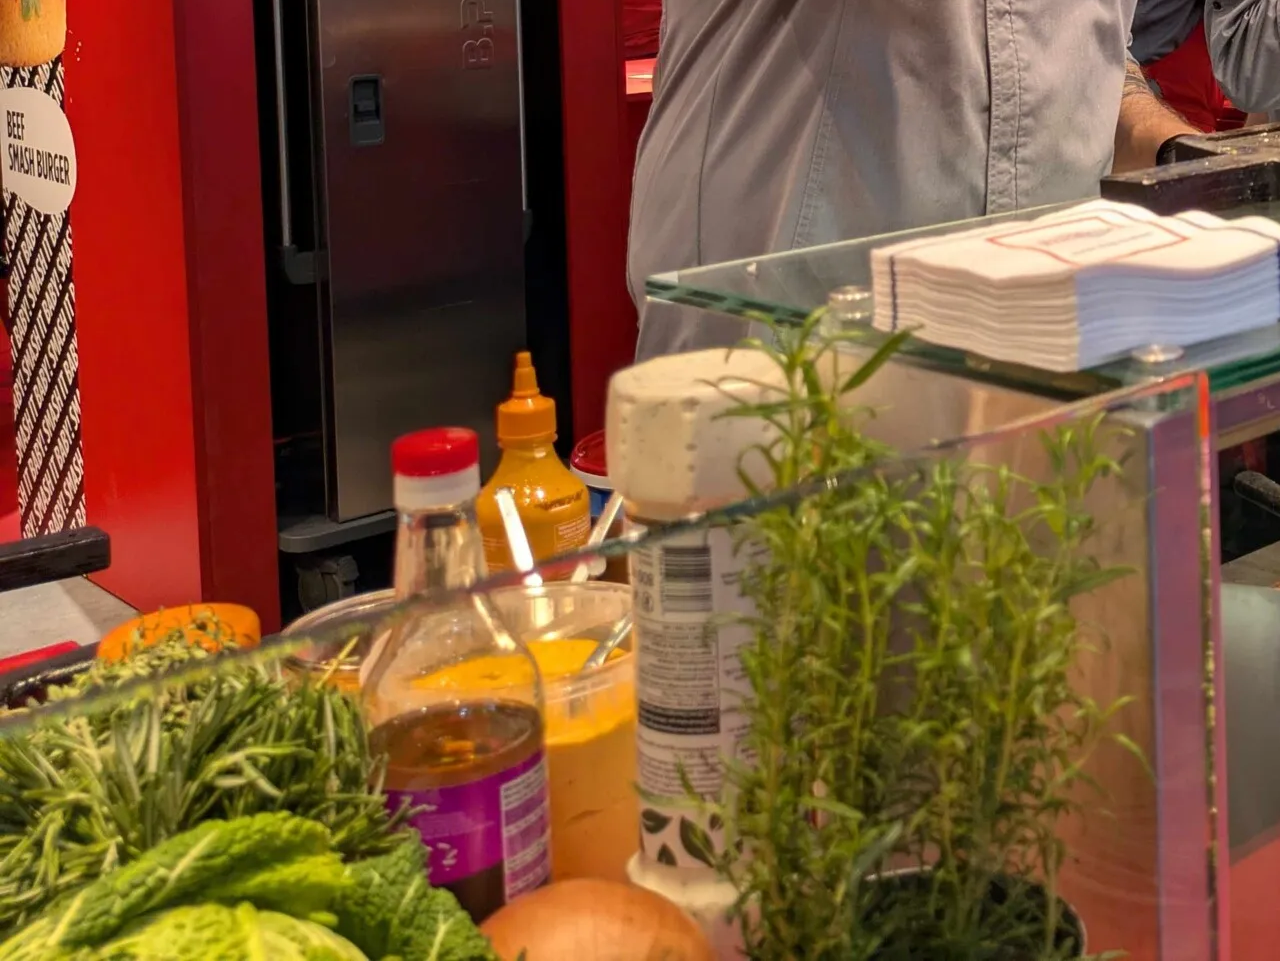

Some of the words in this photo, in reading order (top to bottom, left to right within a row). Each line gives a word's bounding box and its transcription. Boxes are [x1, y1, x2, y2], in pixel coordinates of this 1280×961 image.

[6, 110, 25, 141] BEEF
[8, 143, 36, 177] SMASH
[36, 149, 71, 186] BURGER
